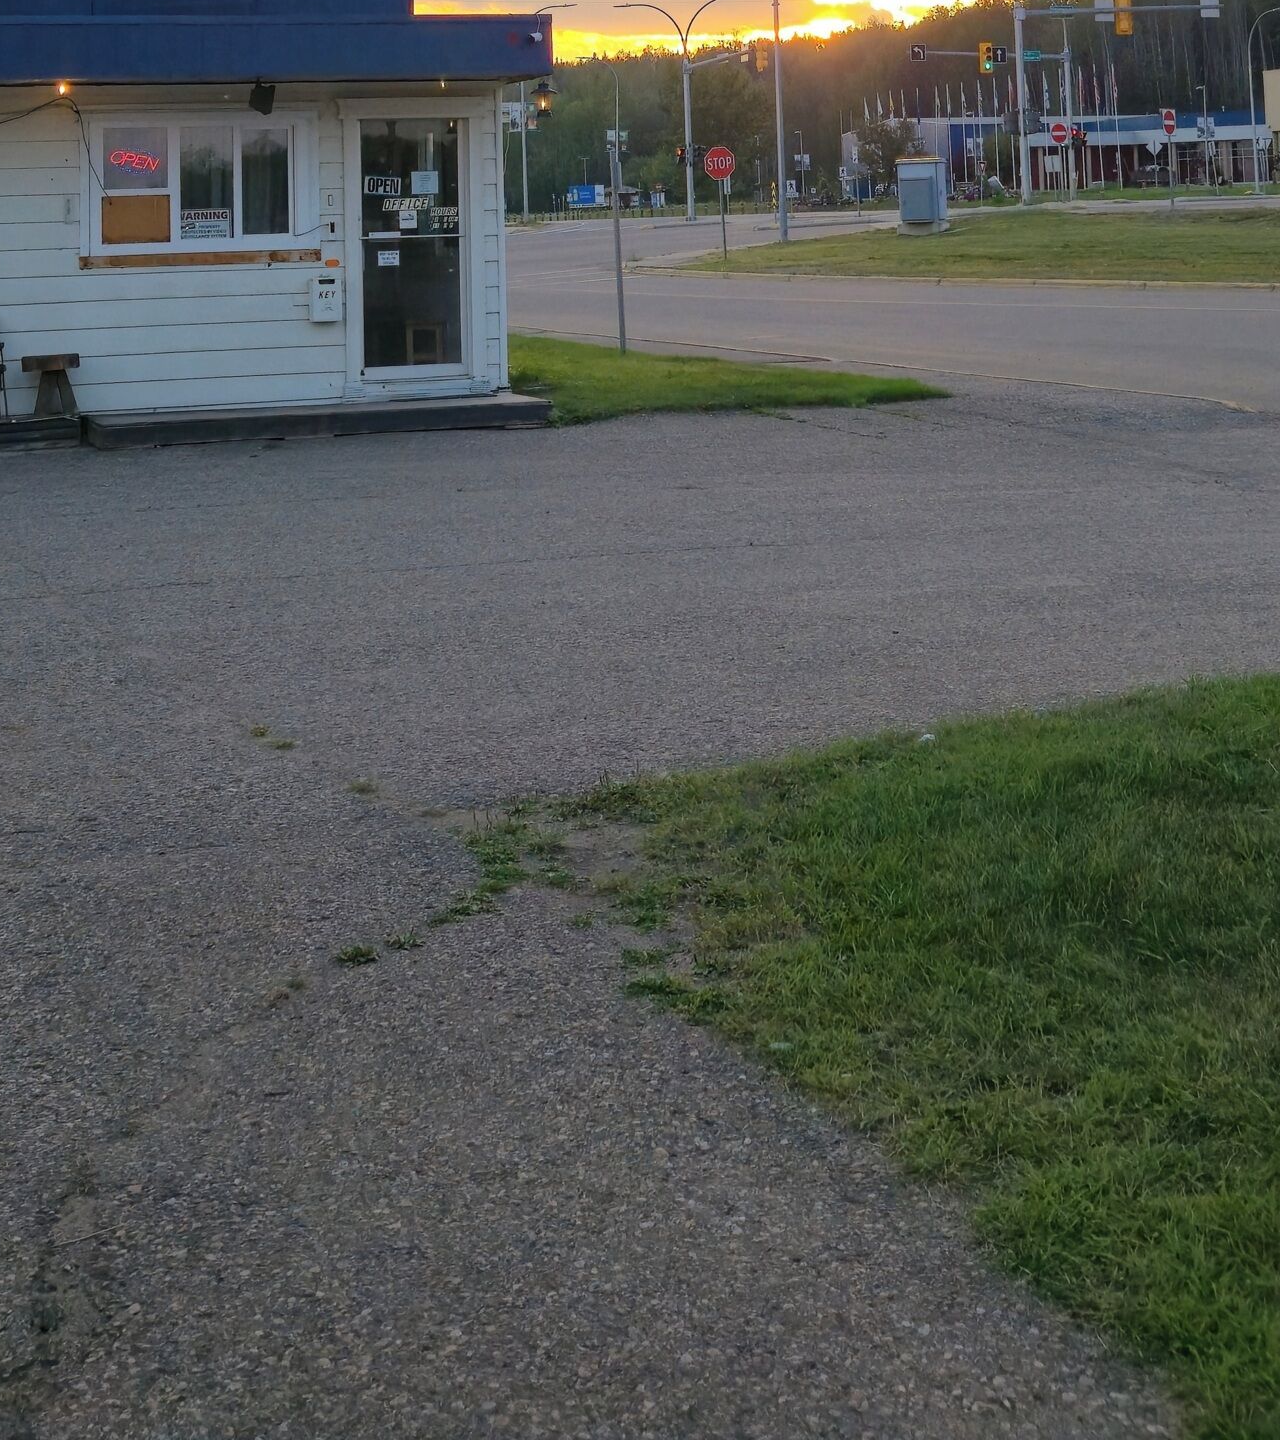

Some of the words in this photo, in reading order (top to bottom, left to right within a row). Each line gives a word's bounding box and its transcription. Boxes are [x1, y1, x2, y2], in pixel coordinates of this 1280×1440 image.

[110, 150, 160, 171] OPEN
[707, 156, 731, 170] STOP
[367, 177, 399, 194] OPEN
[384, 198, 428, 210] OFFICE
[431, 207, 456, 216] HOURS
[318, 290, 337, 300] KEY
